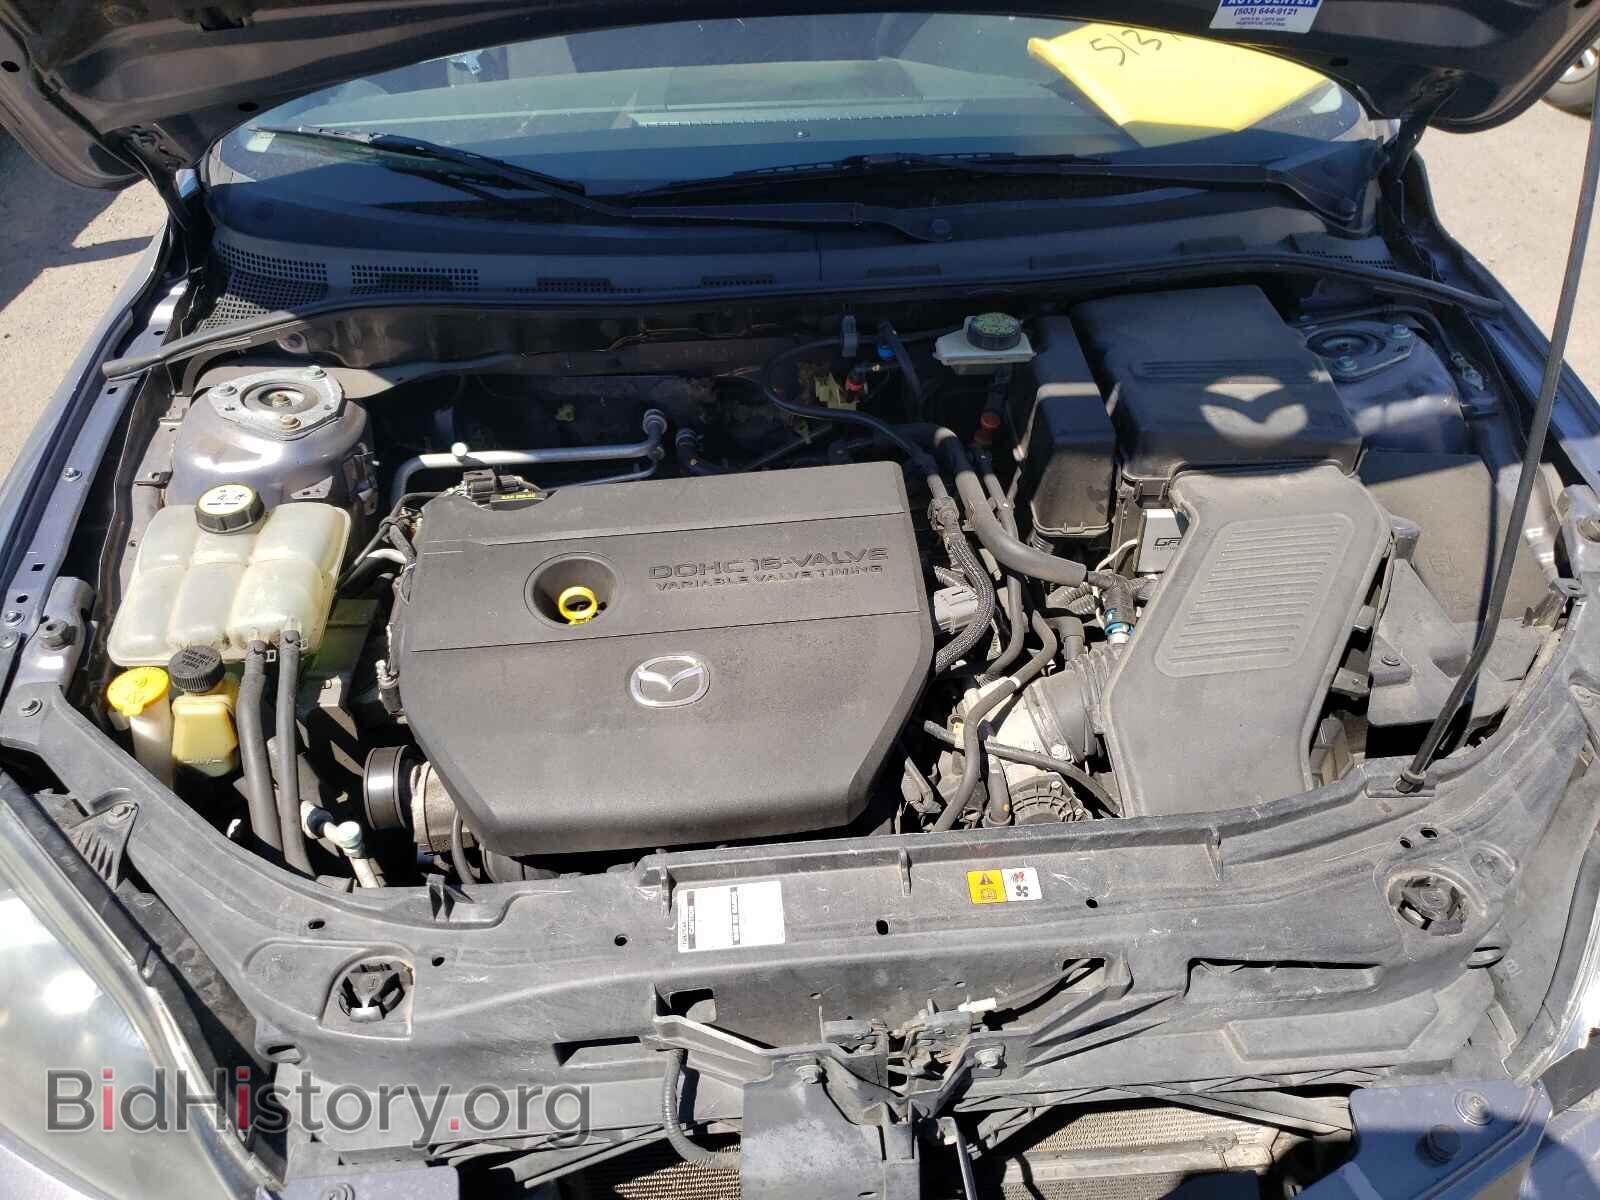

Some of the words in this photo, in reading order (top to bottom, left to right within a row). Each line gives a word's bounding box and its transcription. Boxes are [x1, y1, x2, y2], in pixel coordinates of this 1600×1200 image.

[1234, 7, 1257, 16] (503)
[754, 570, 812, 585] VALVE
[817, 564, 884, 578] TIMING
